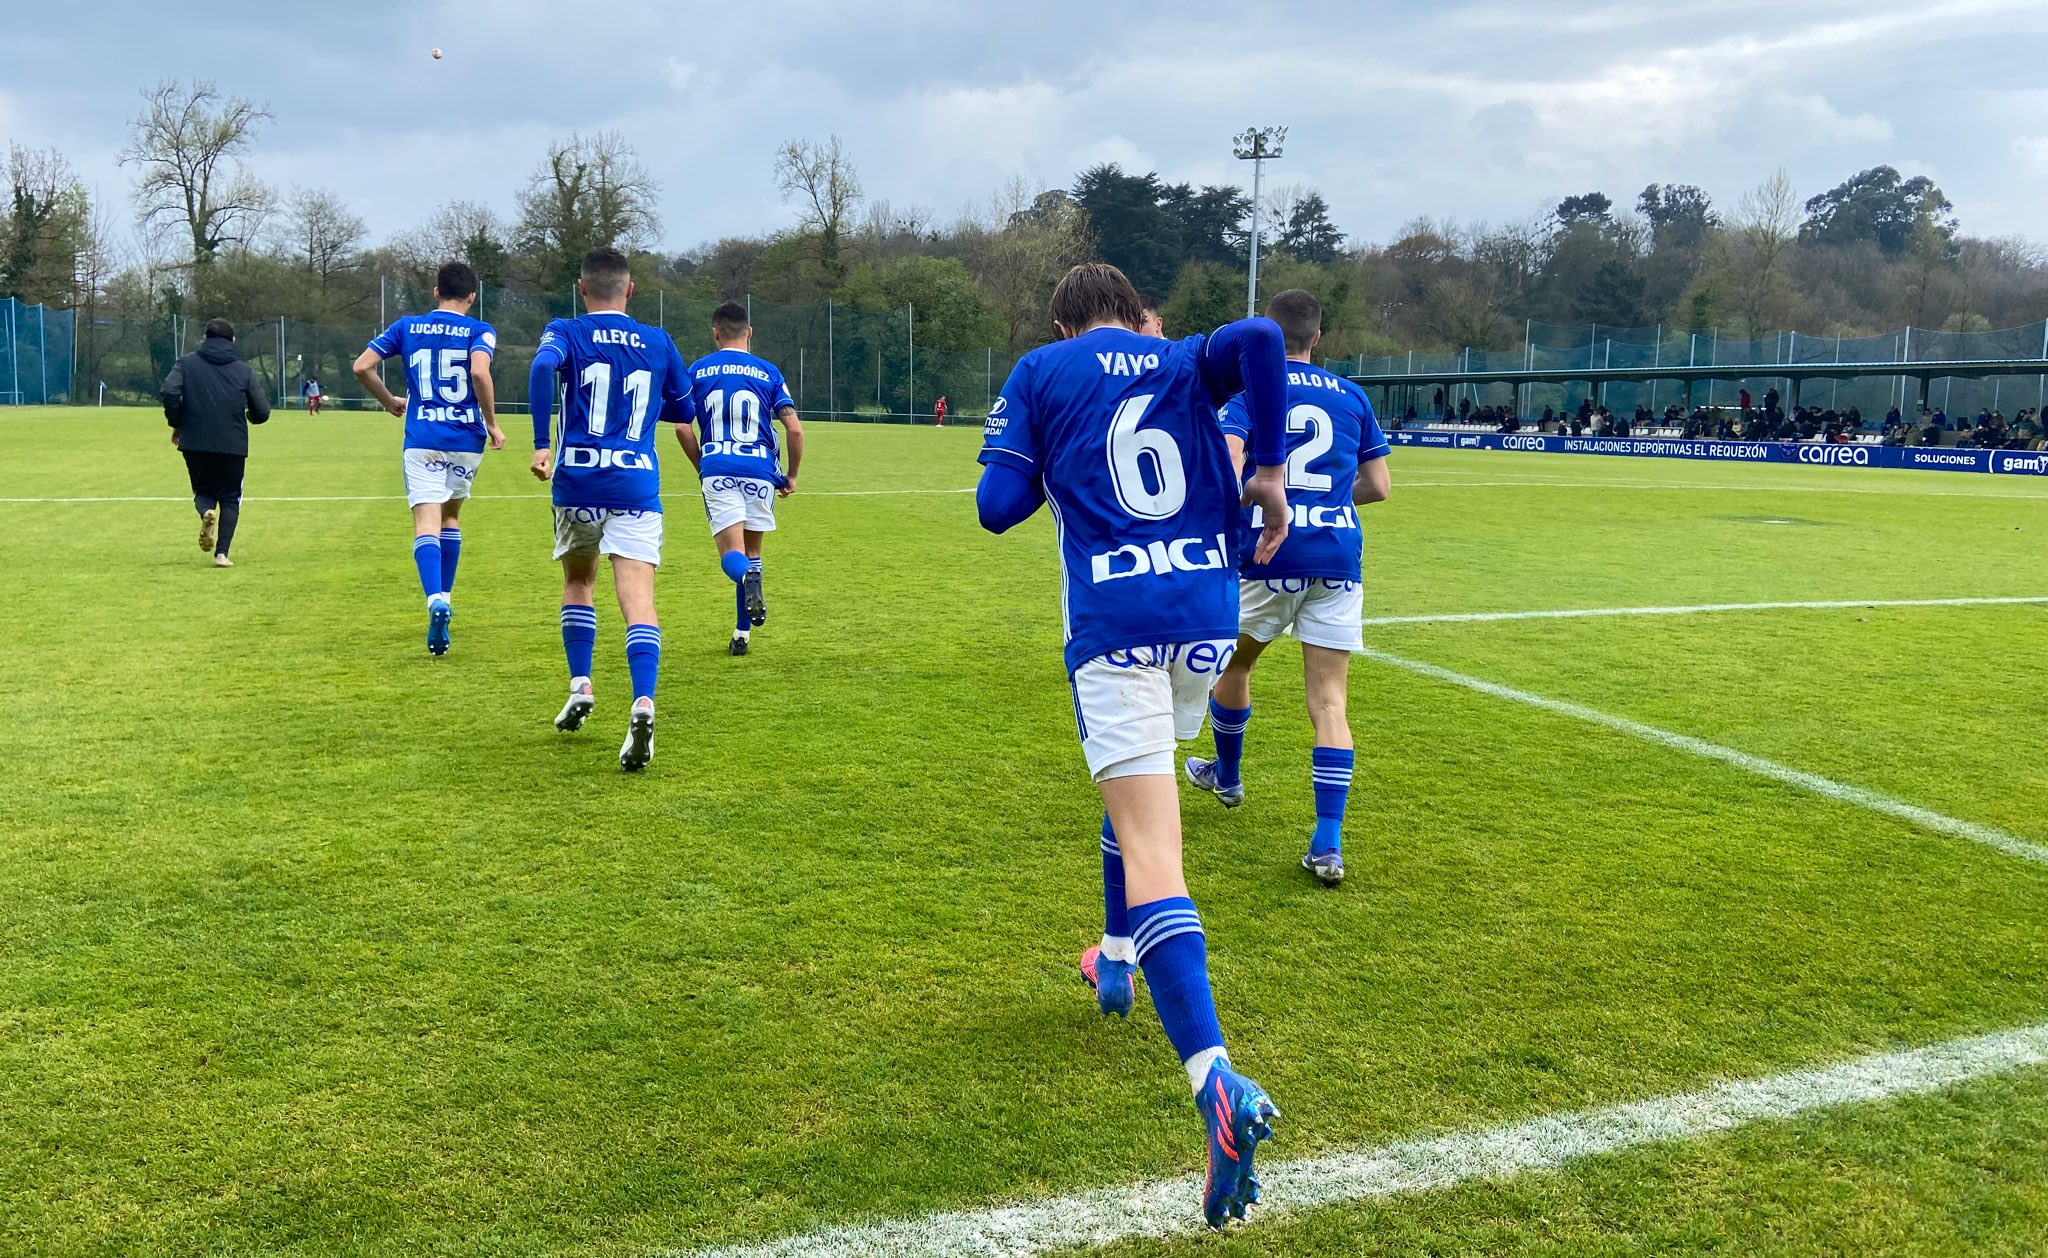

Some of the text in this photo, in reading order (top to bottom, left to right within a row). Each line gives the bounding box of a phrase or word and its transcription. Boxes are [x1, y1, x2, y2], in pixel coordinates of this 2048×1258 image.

[409, 323, 471, 338] LUCAS LASO
[592, 329, 646, 349] ALEX C.
[695, 364, 770, 383] ELOY ORDÓÑEZ
[1095, 351, 1159, 377] YAYO
[409, 348, 468, 403] 15
[1287, 372, 1347, 395] BLO M.
[580, 362, 652, 442] 11
[416, 404, 475, 424] DIGI
[704, 389, 760, 444] 10
[701, 441, 768, 459] DIGI
[1285, 404, 1334, 492] 2
[1421, 436, 1449, 444] SOLUCIONES
[1502, 435, 1545, 451] carrea
[1564, 439, 1768, 459] INSTALACIONES DEPORTIVAS EL REQUEXÓN
[564, 446, 654, 471] DIGI
[1106, 393, 1187, 521] 6
[1798, 445, 1869, 465] carrea
[1914, 453, 1976, 466] SOLUCIONES
[1092, 533, 1229, 584] DIGI
